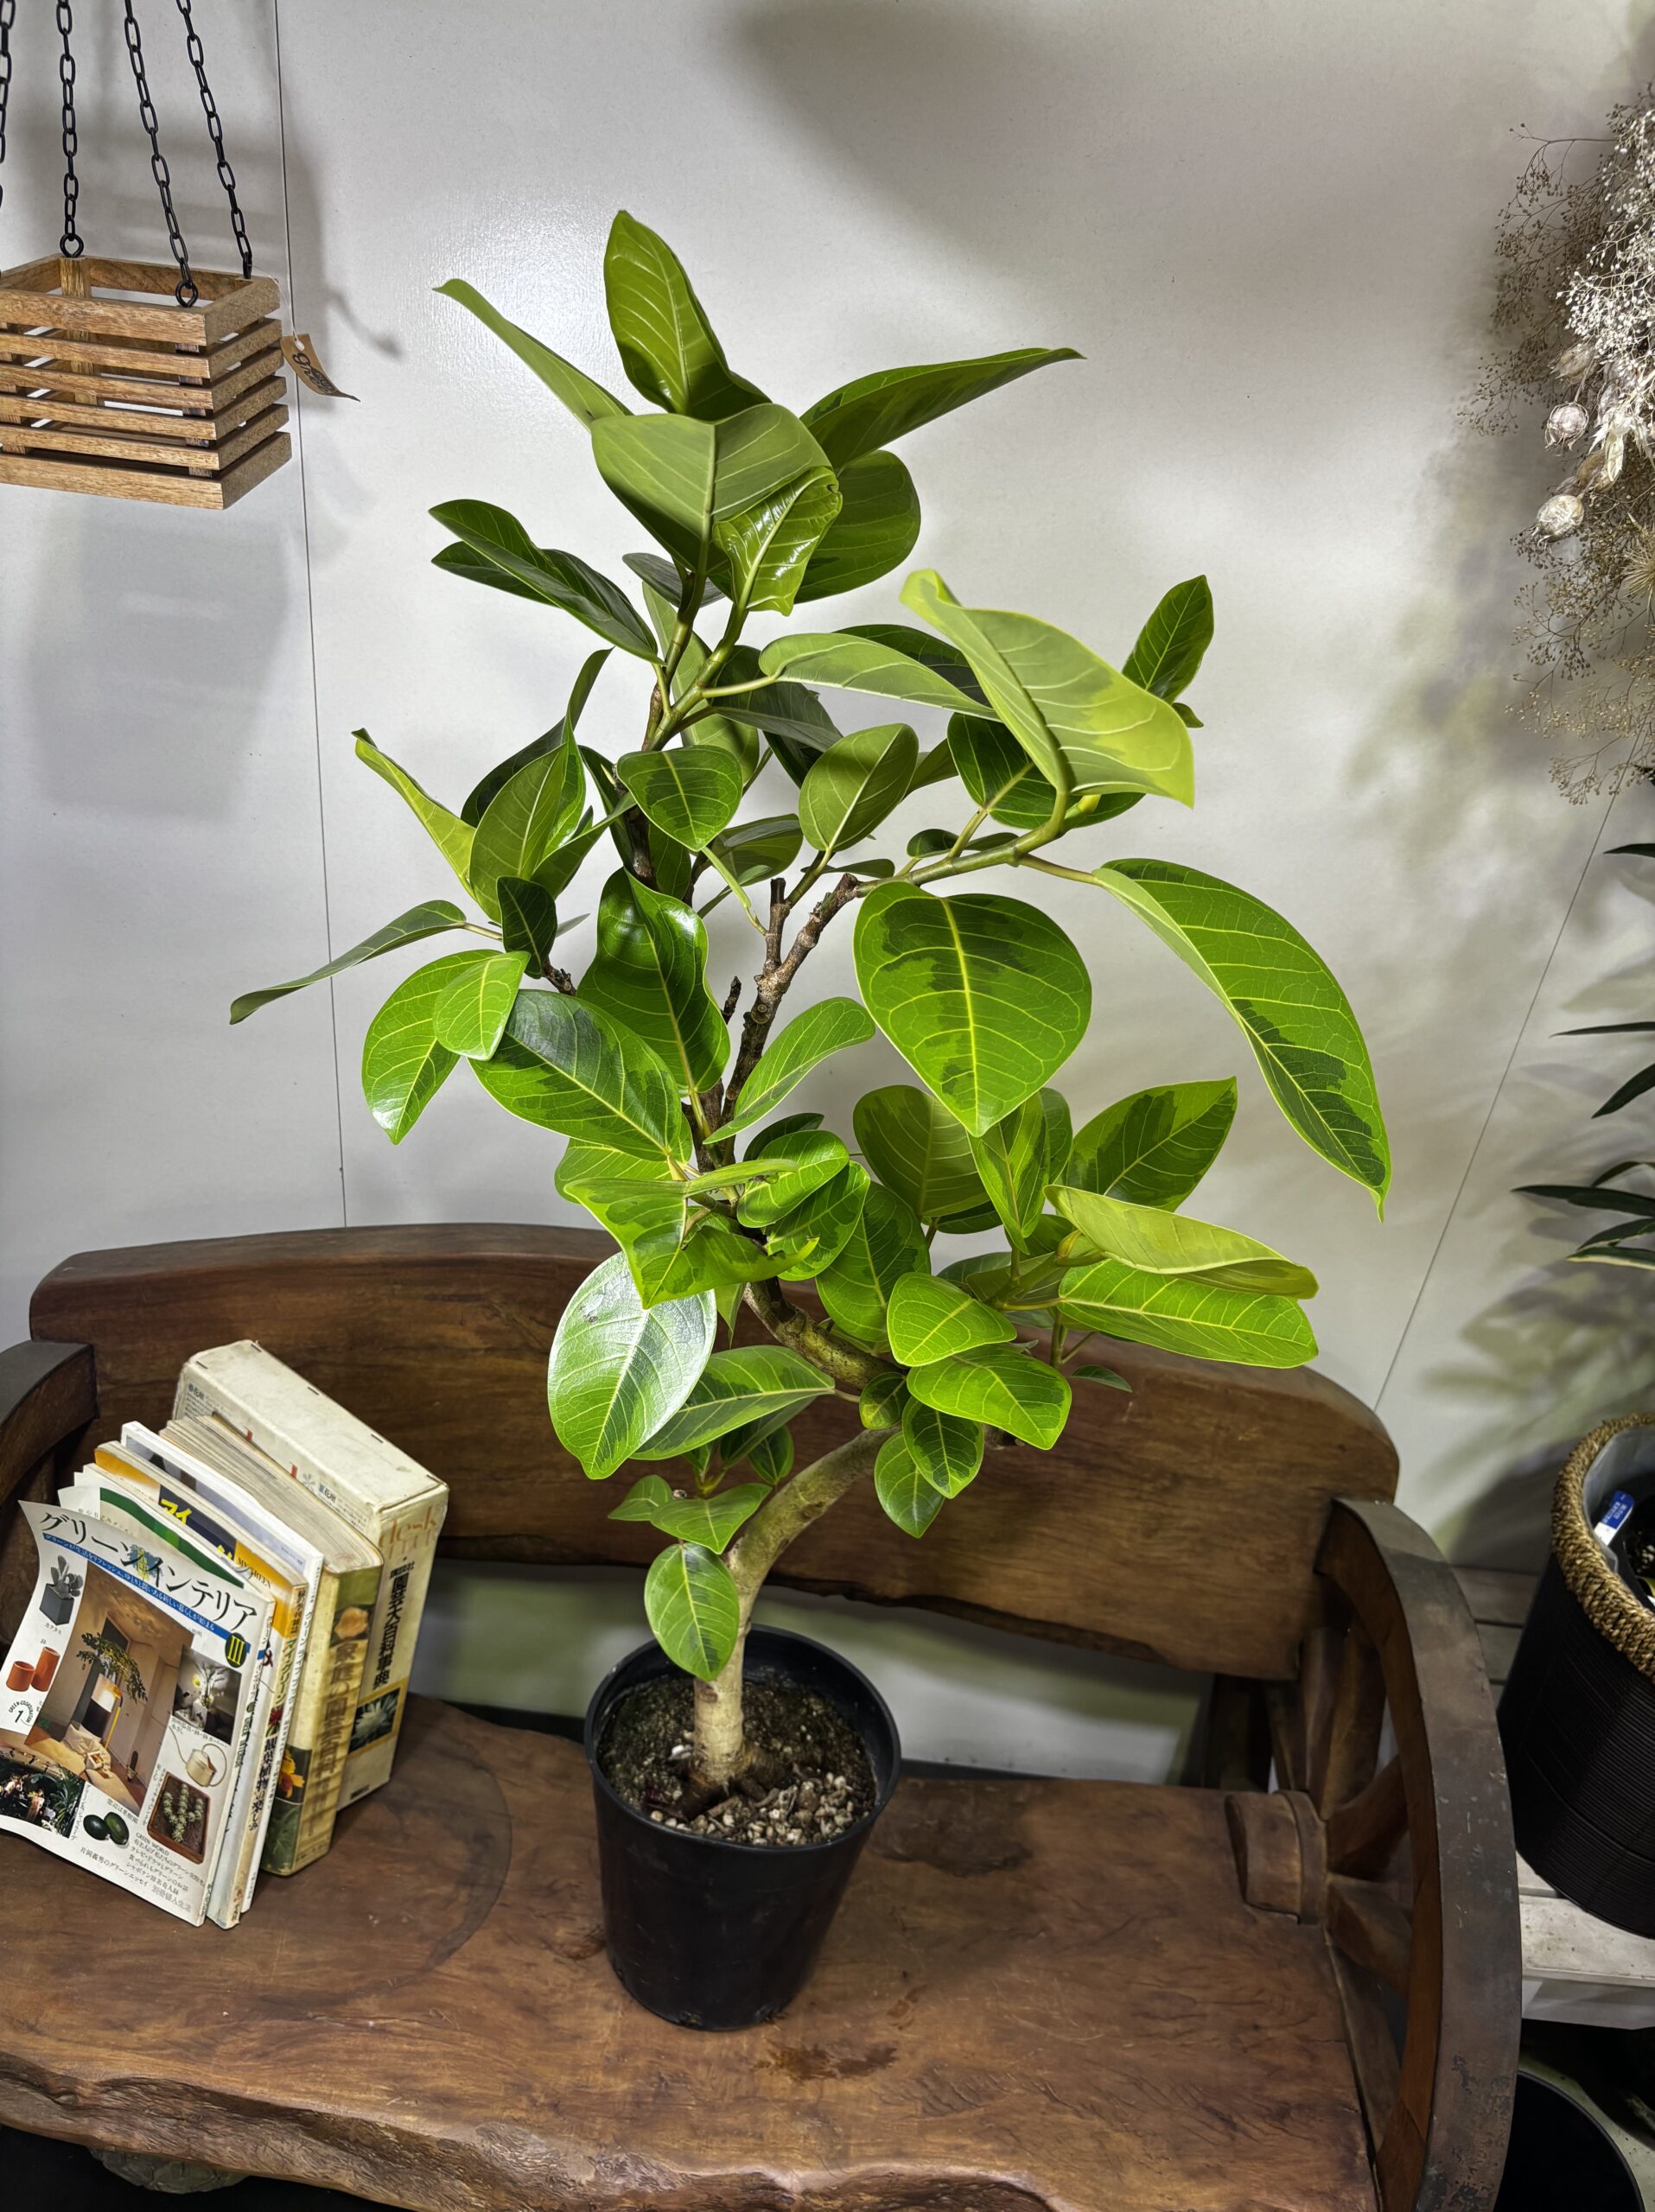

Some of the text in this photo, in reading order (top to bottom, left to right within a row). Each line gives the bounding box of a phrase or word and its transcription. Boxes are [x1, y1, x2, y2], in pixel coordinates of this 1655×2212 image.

[41, 1512, 258, 1630] グリーンインテリア
